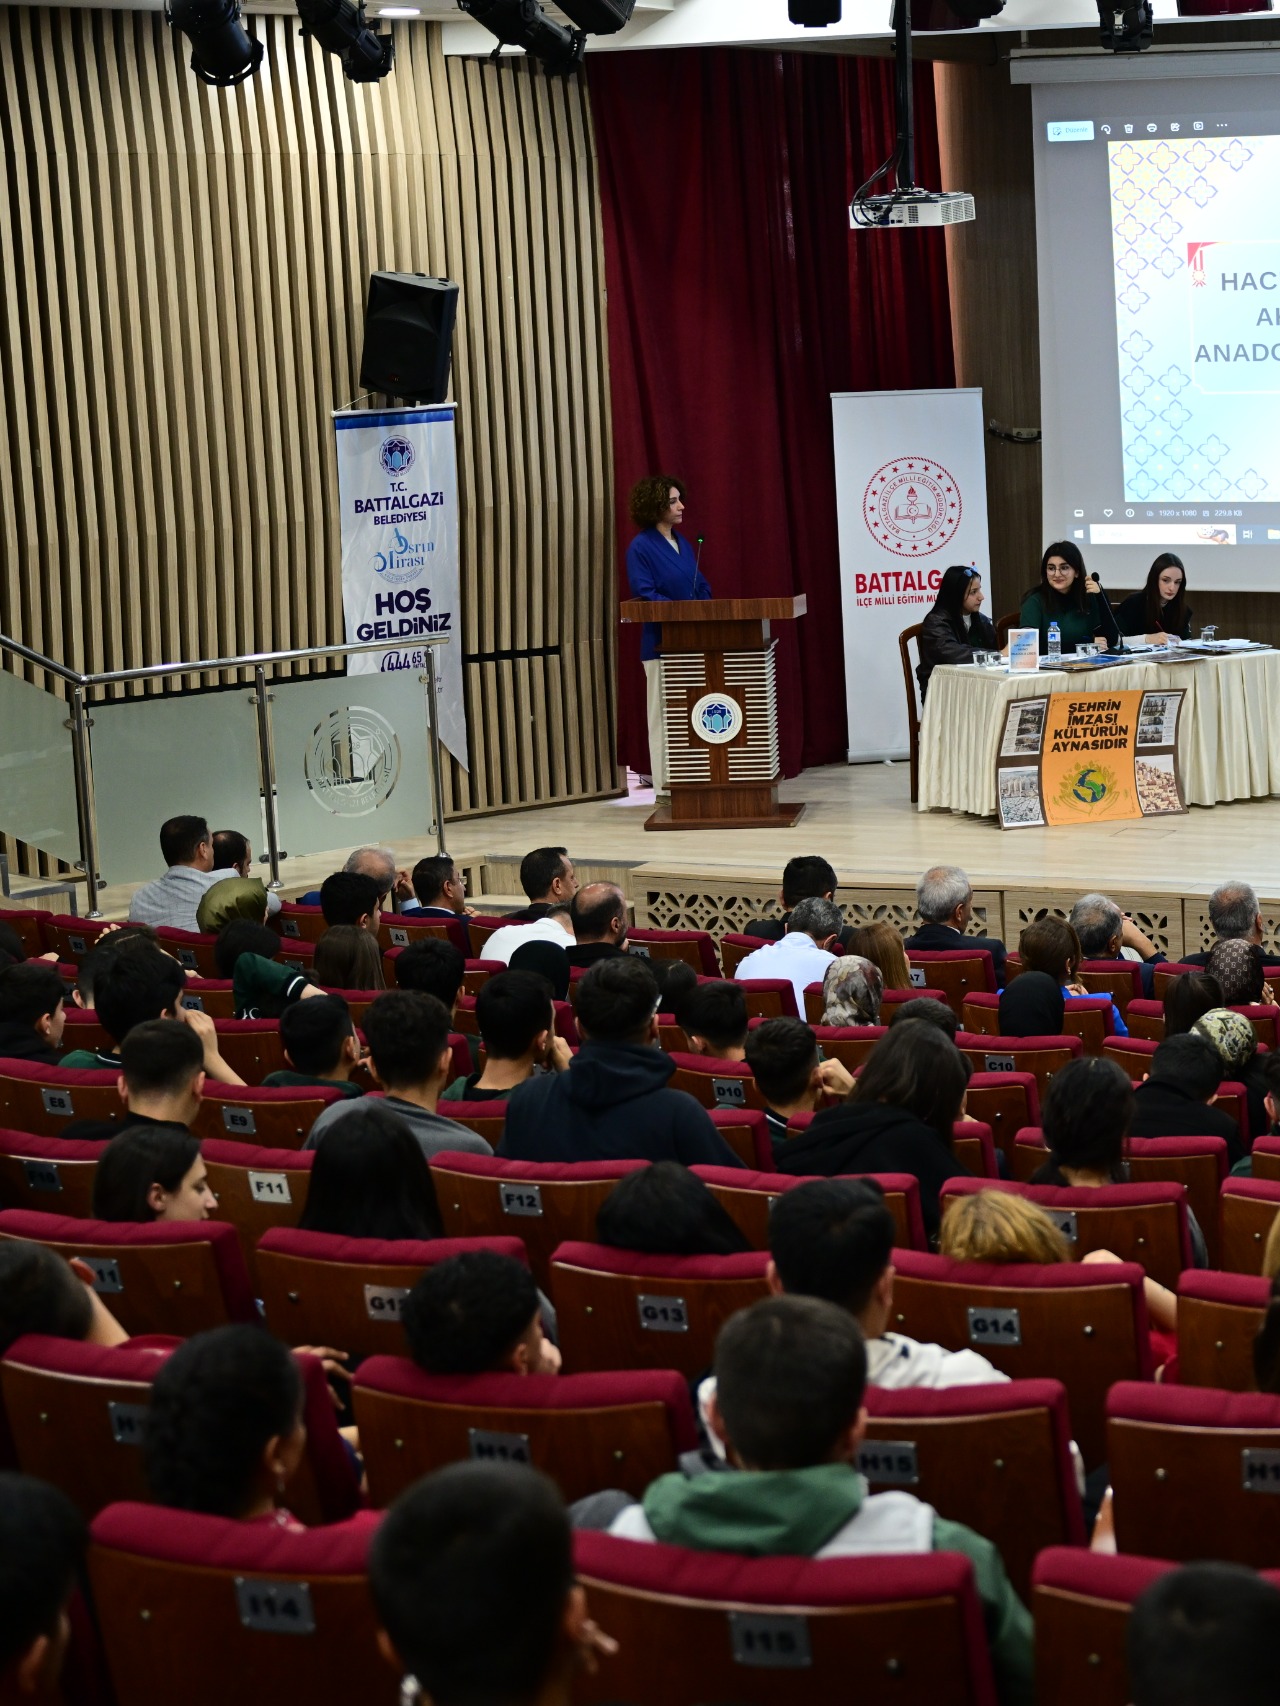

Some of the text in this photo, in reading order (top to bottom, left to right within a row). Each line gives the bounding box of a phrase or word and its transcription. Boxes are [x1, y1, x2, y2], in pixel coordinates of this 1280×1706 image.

[390, 482, 407, 492] T.C.
[1181, 509, 1197, 517] 1080
[855, 569, 943, 594] BATTALG
[375, 587, 432, 617] HOŞ
[856, 595, 873, 608] İLÇE
[875, 594, 895, 606] MİLLİ
[897, 593, 925, 605] EĞİTİM
[411, 651, 422, 664] 65
[1068, 699, 1122, 716] ŞEHRİN
[1068, 713, 1118, 726] İMZASI
[1053, 722, 1129, 740] KÜLTÜRÜN
[1051, 737, 1128, 753] AYNASIDIR
[395, 933, 404, 942] A3
[186, 1001, 199, 1010] C5
[988, 1061, 1013, 1071] C10
[716, 1086, 743, 1098] D10
[49, 1096, 66, 1109] E8
[230, 1114, 248, 1127] E9
[255, 1180, 284, 1195] F11
[504, 1193, 537, 1208] F12
[98, 1268, 118, 1284] 11
[370, 1296, 397, 1312] G1
[643, 1305, 685, 1323] G13
[973, 1318, 1017, 1335] G14
[859, 1452, 915, 1472] H15
